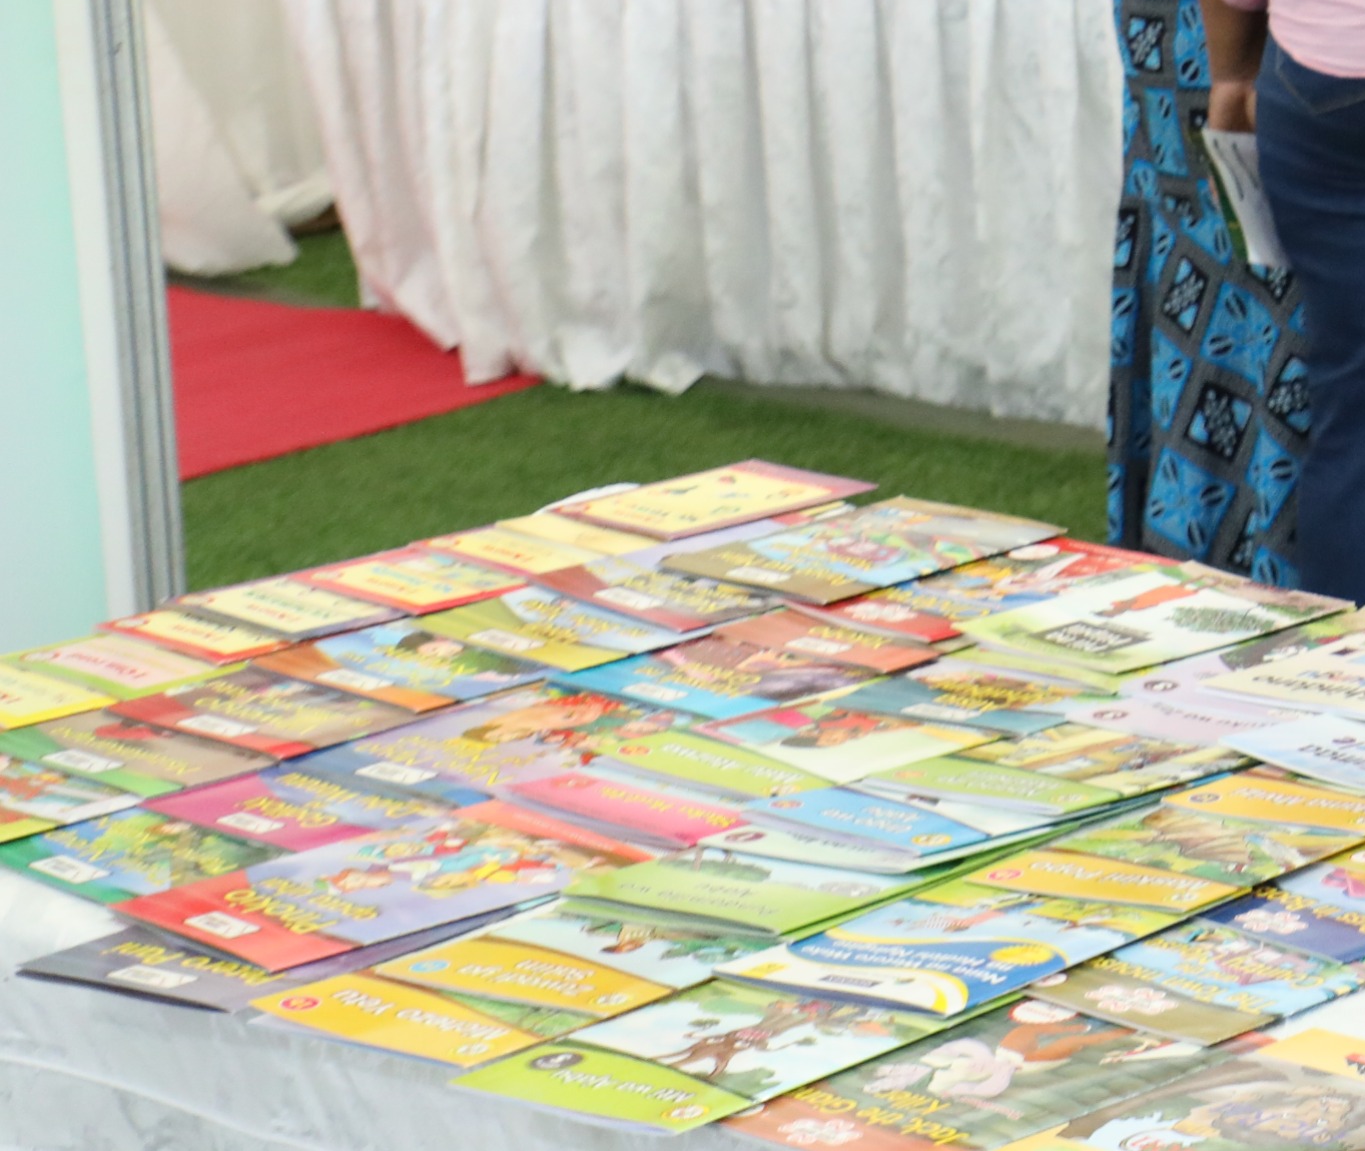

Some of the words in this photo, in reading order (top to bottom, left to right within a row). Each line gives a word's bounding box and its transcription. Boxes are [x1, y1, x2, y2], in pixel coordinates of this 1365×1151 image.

[332, 988, 396, 1017] Yetu
[792, 1086, 858, 1117] Gian
[856, 1106, 898, 1128] the
